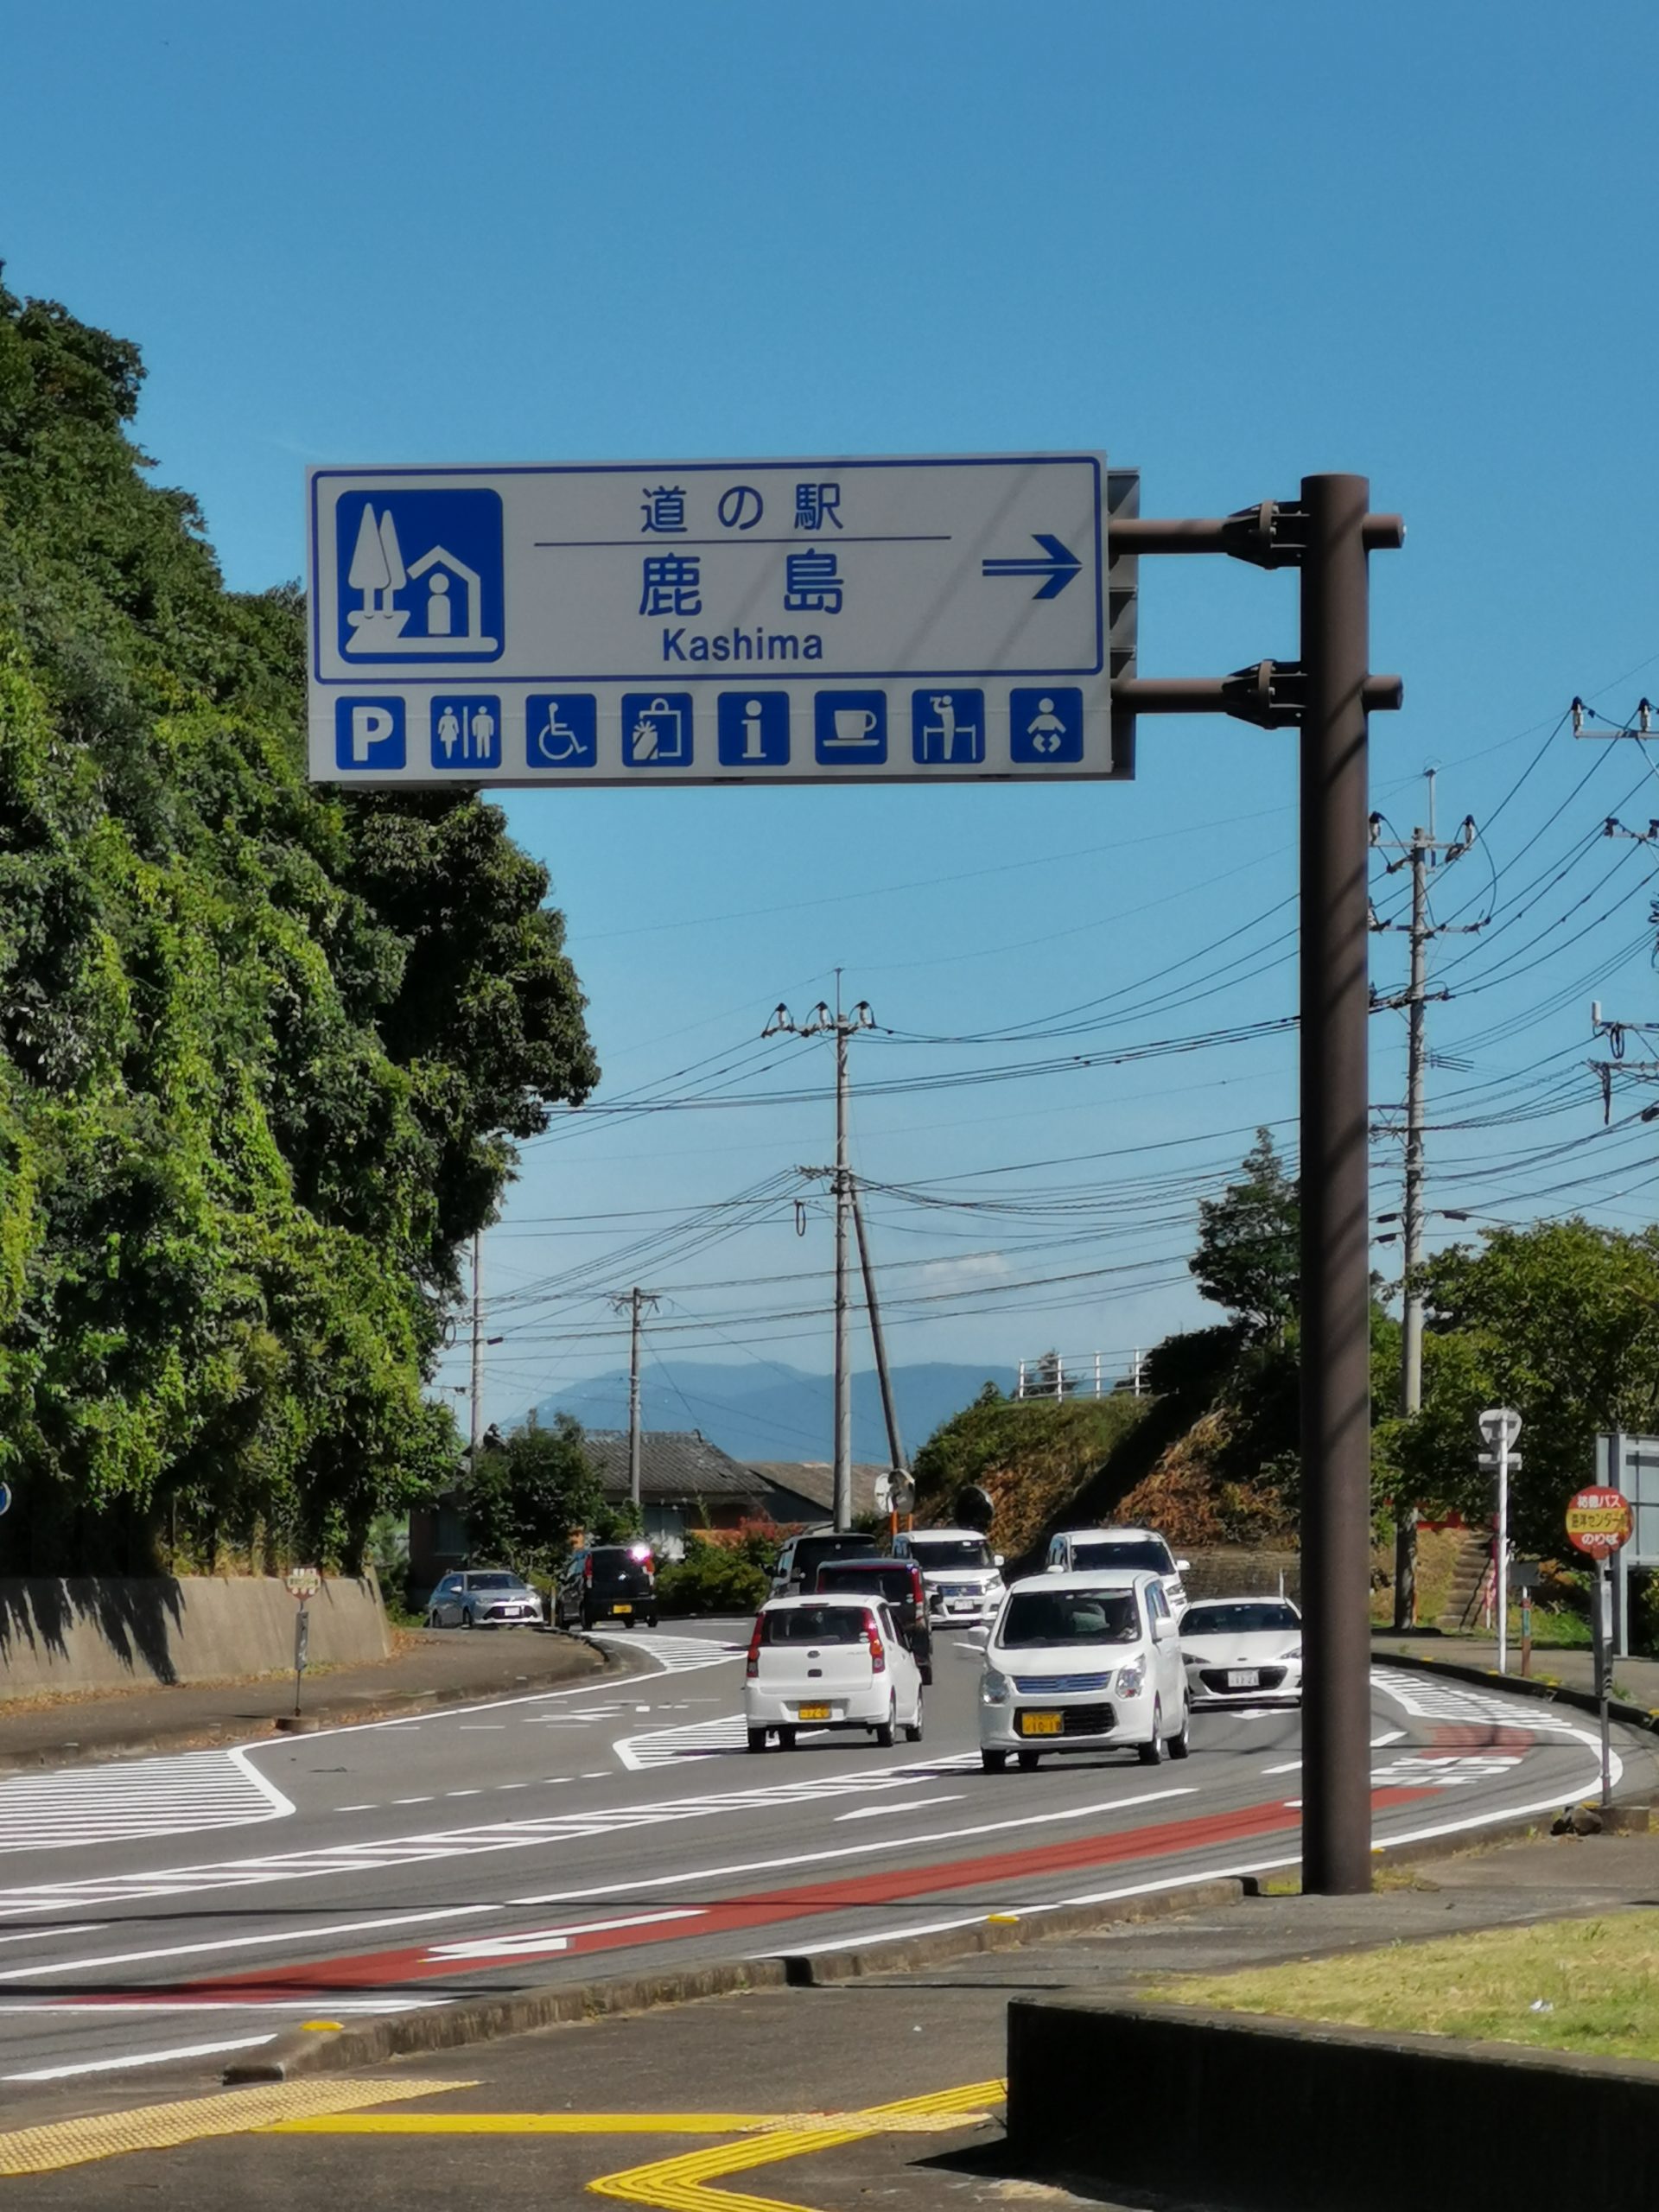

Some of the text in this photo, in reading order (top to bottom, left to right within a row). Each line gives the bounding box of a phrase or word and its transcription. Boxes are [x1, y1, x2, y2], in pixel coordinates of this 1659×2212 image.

[640, 483, 843, 532] 道の駅
[639, 548, 844, 617] 鹿島
[663, 626, 823, 661] Kashima
[1581, 1532, 1619, 1545] のりば
